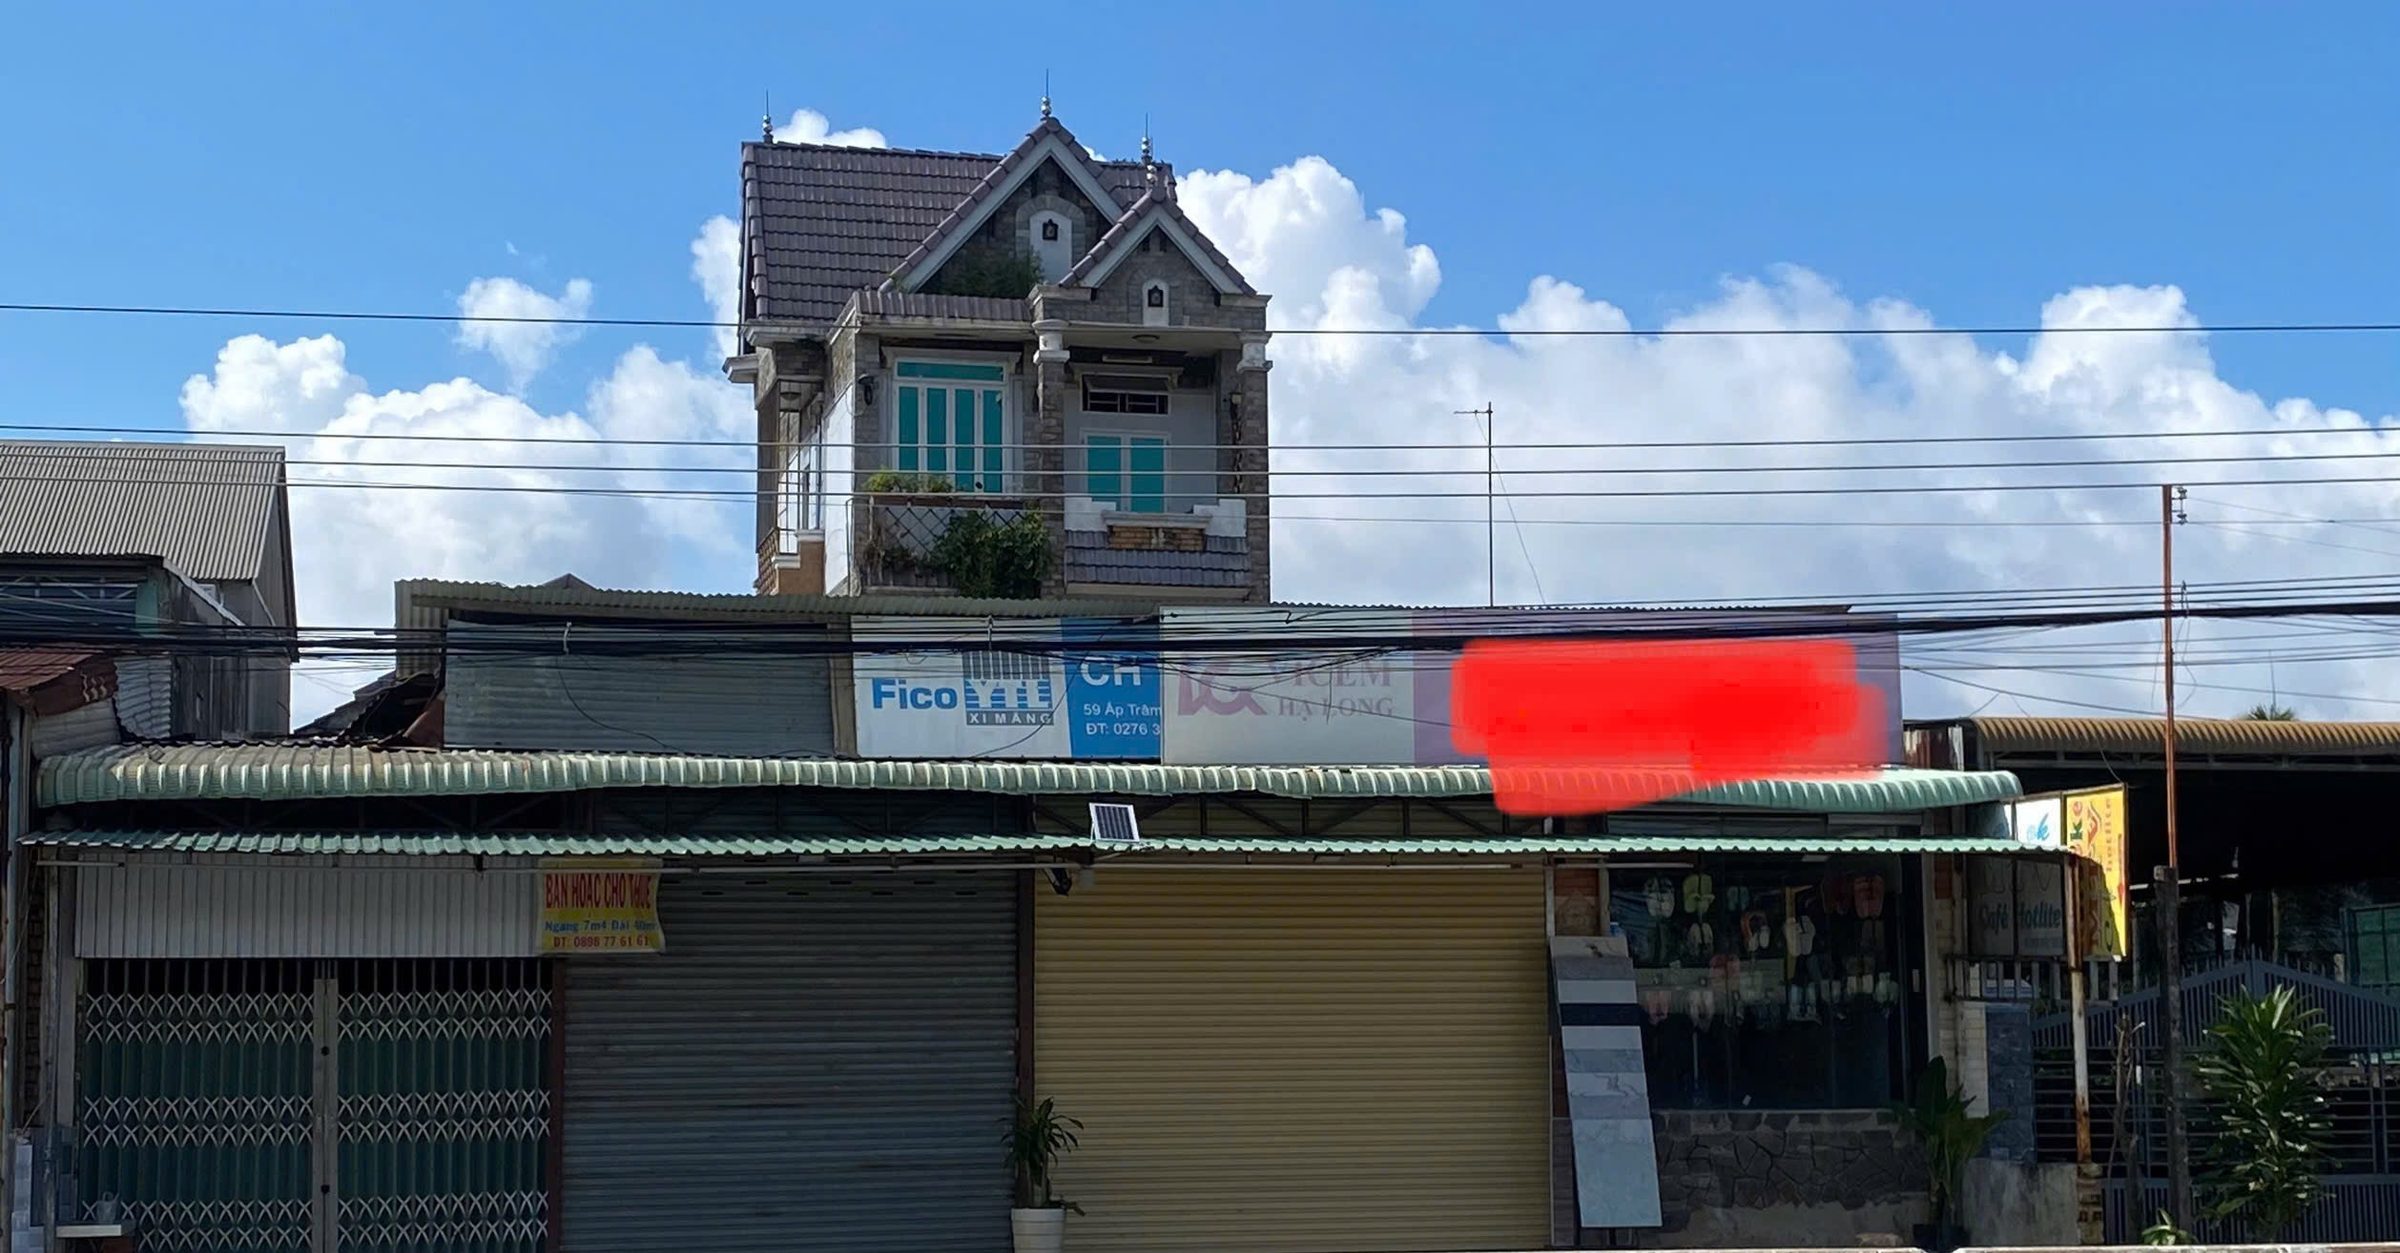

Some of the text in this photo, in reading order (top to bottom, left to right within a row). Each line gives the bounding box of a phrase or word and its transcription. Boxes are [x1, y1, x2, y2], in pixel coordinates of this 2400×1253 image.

[872, 677, 1050, 709] Fico YTL
[1083, 703, 1101, 716] 59
[1322, 698, 1393, 716] LONG
[969, 712, 987, 724] XI
[1113, 723, 1147, 735] 0276
[604, 873, 627, 909] CHO
[544, 920, 578, 933] Ngang
[583, 920, 607, 931] 7m4
[603, 936, 616, 948] 77
[620, 936, 632, 947] 61
[636, 935, 649, 946] 61
